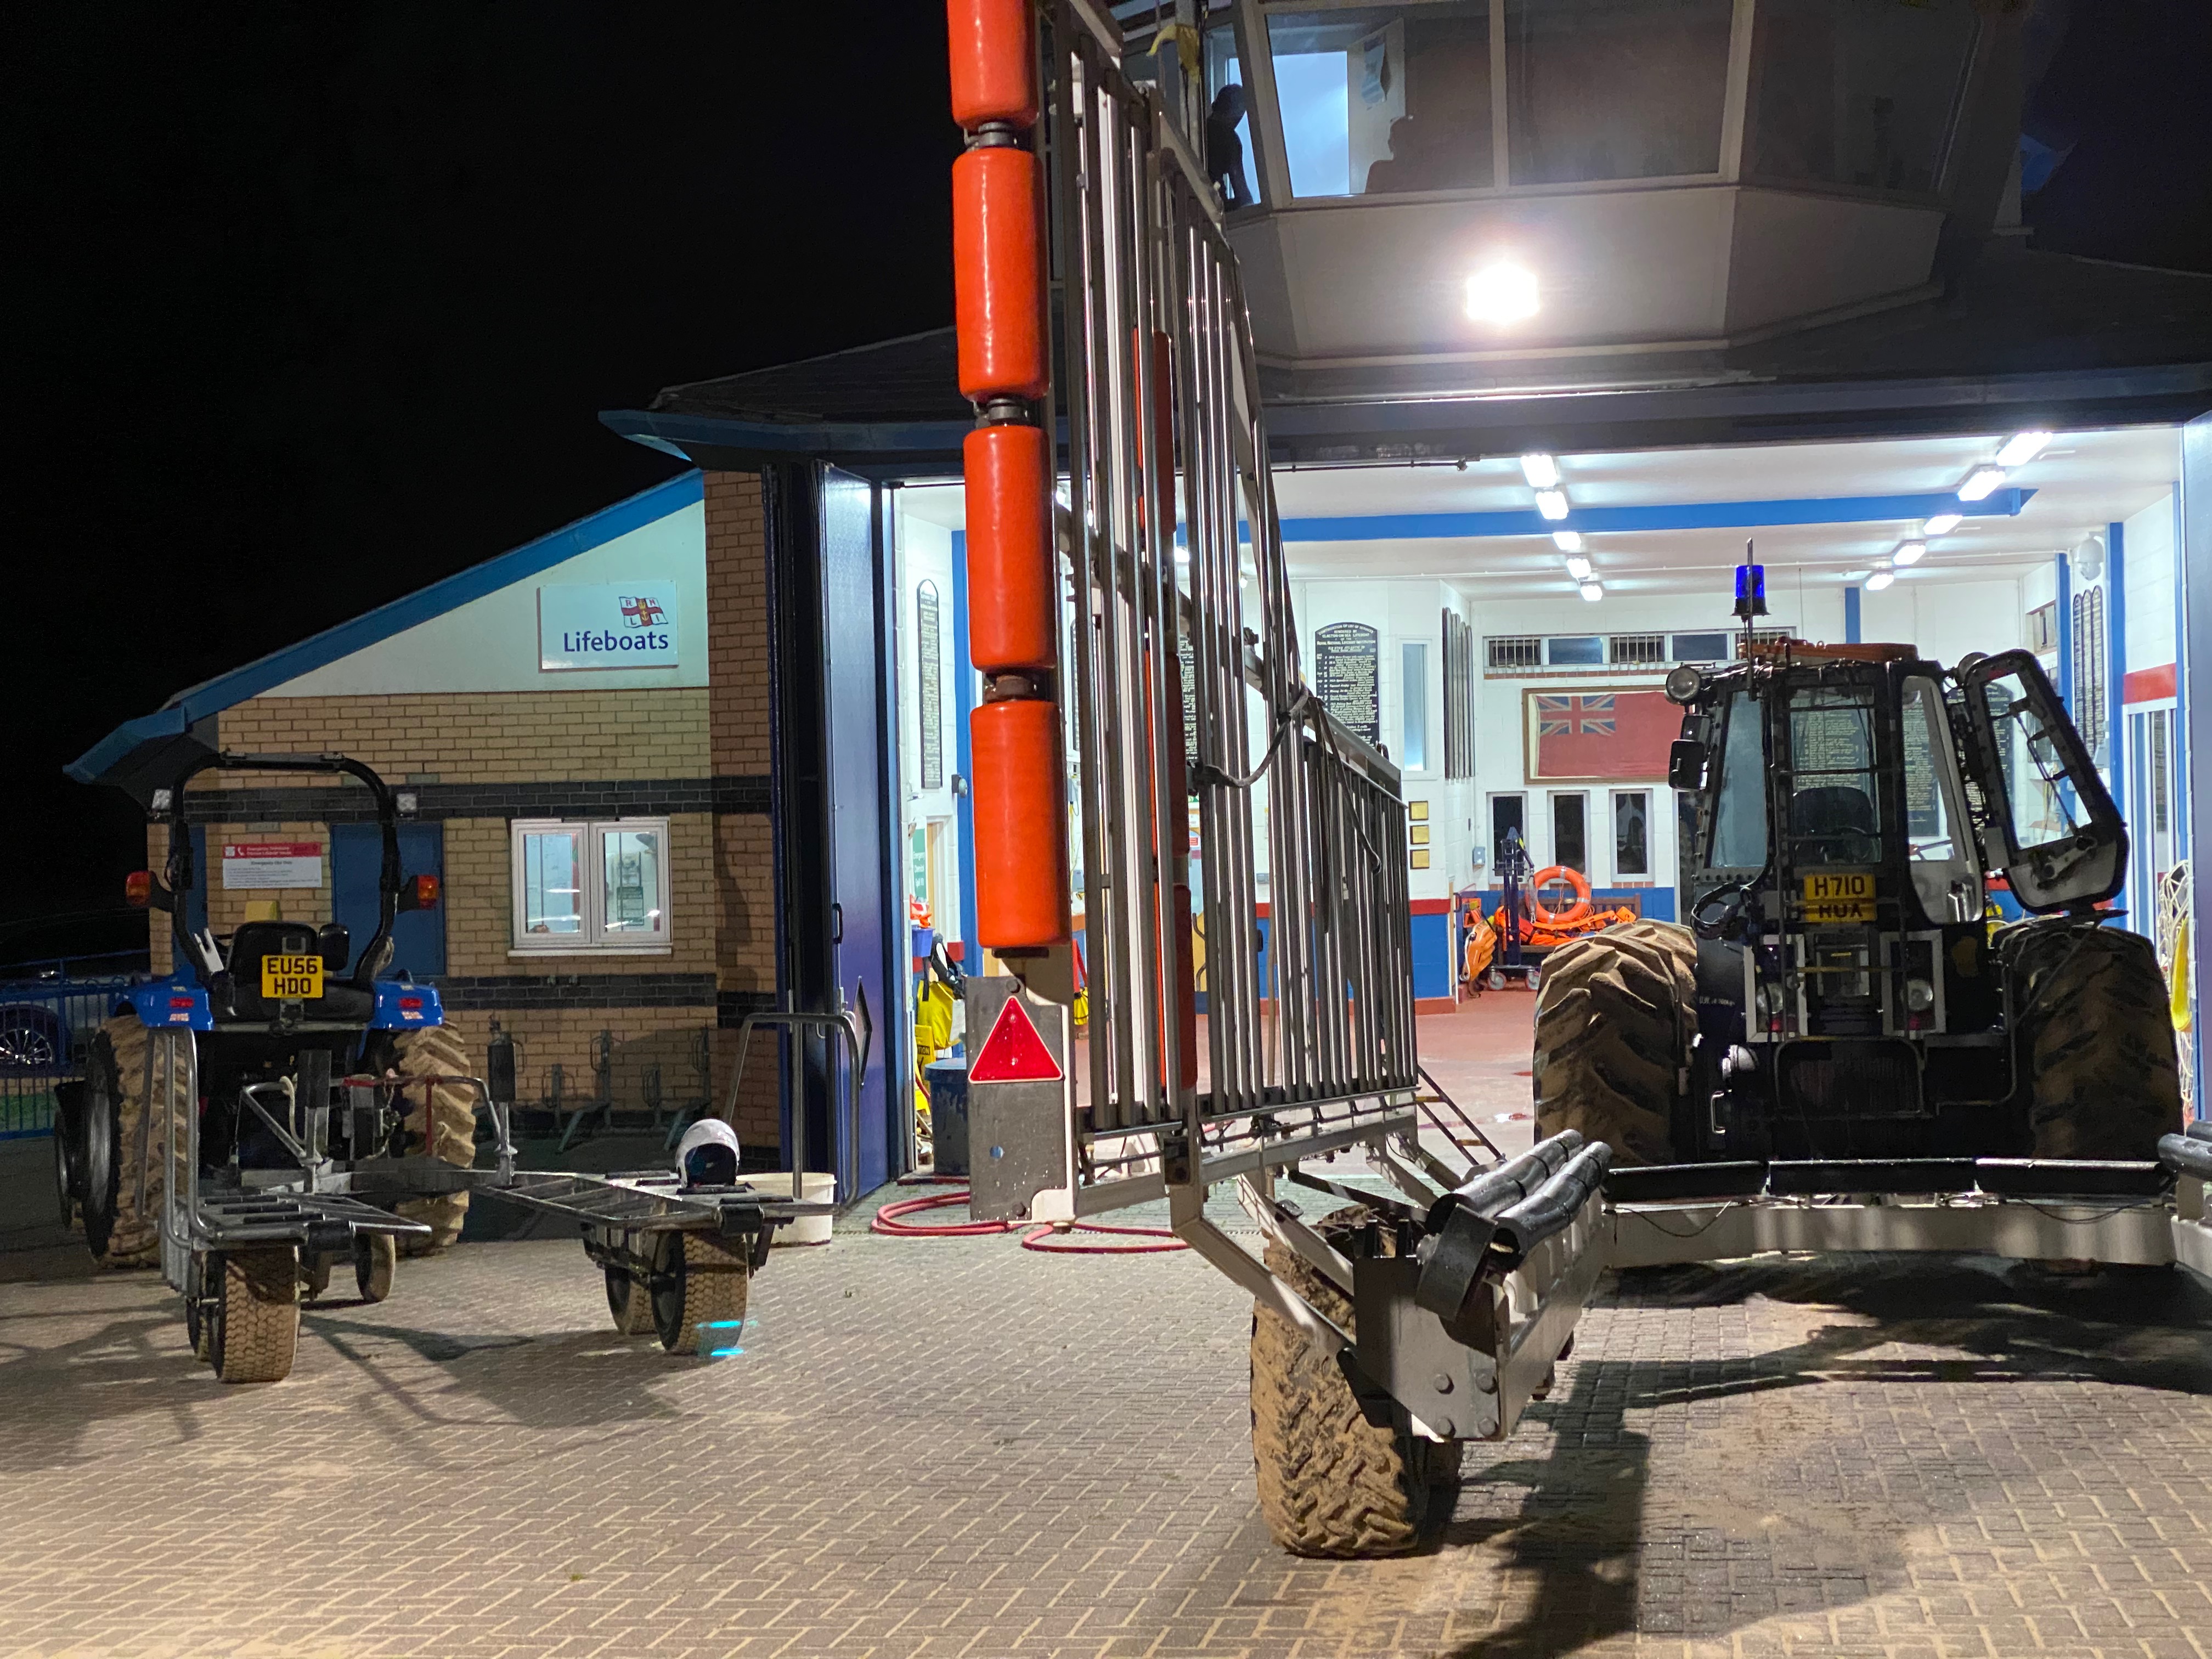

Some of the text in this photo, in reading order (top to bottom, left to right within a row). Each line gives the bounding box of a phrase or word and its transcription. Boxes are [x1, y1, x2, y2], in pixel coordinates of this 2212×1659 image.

[630, 617, 637, 625] L
[564, 629, 669, 652] Lifeboats
[1814, 876, 1865, 896] H710
[267, 957, 318, 974] EU56
[274, 978, 311, 994] HDO
